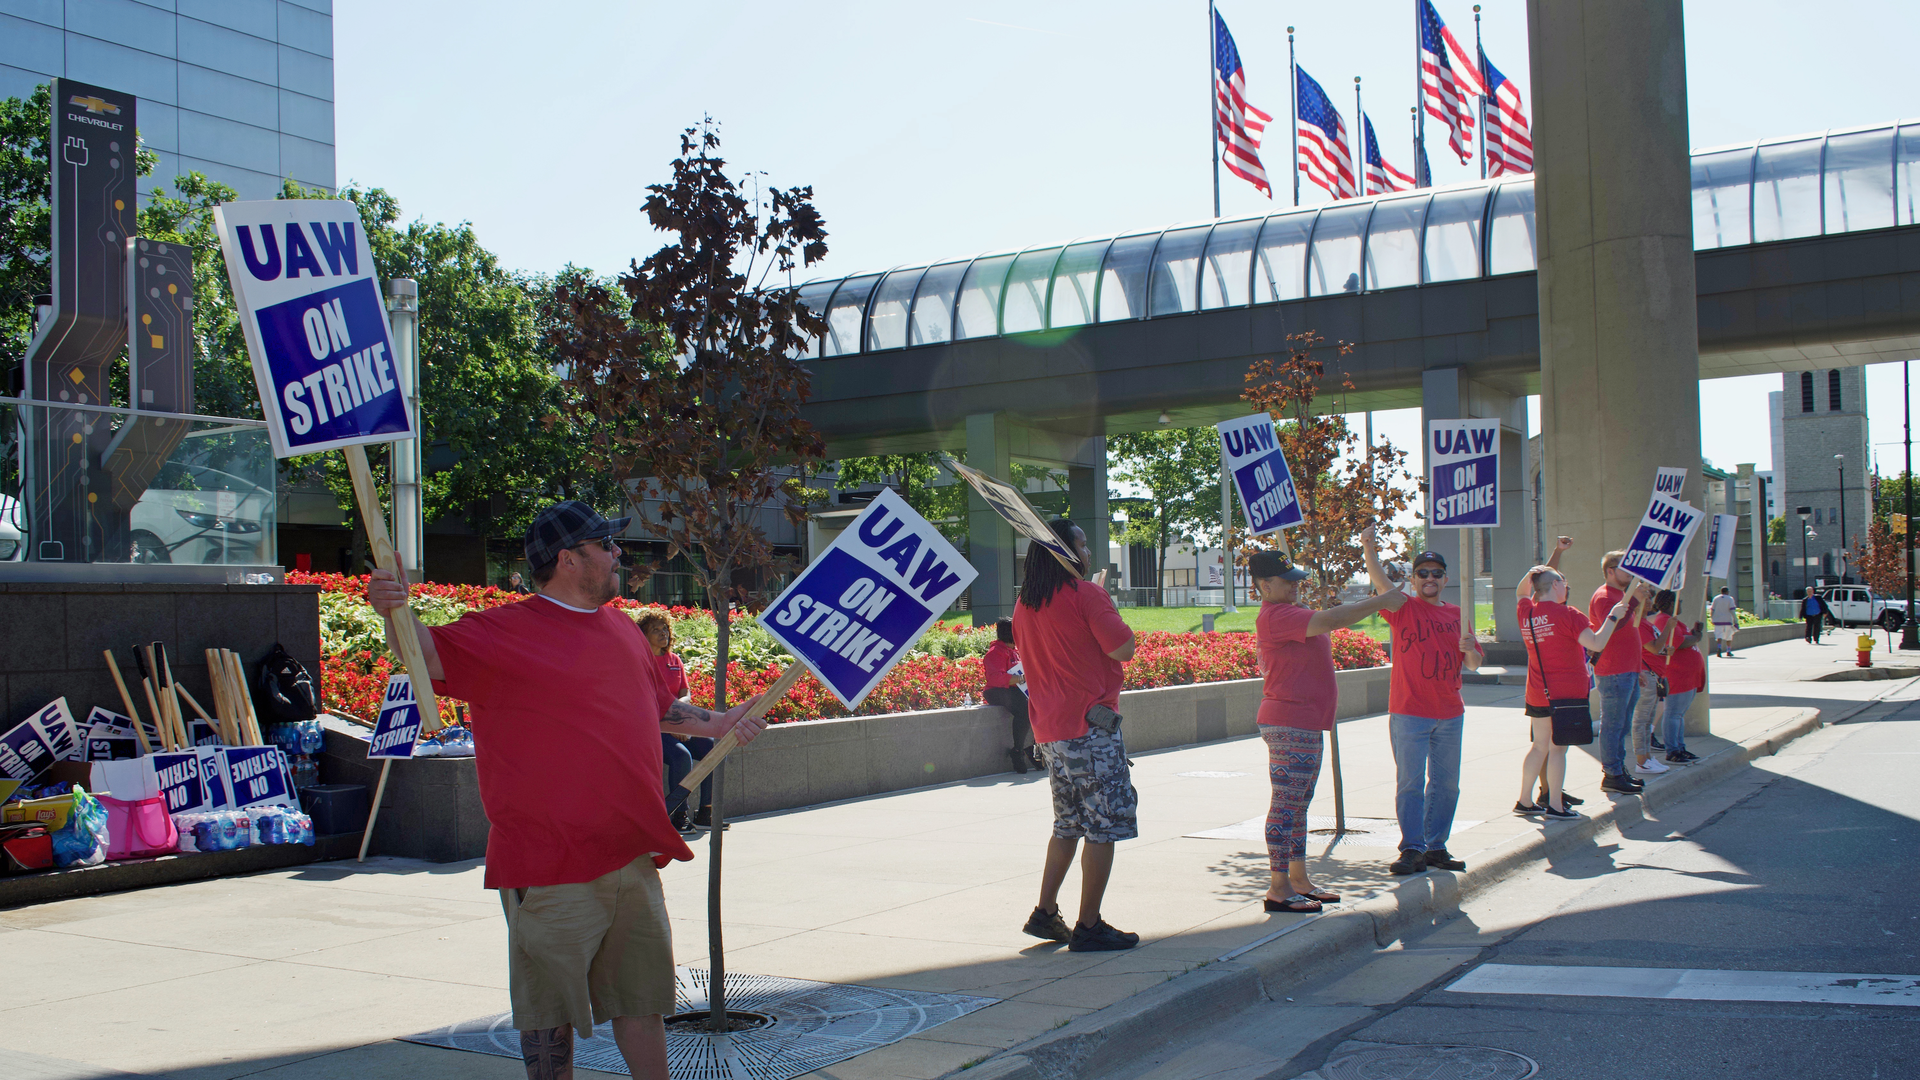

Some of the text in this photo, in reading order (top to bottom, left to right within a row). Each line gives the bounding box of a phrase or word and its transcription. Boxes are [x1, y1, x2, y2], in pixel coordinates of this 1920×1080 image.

[68, 112, 124, 131] CHEVROLET
[236, 222, 359, 281] UAW
[303, 297, 352, 361] ON
[283, 341, 395, 435] STRIKE
[1223, 422, 1274, 458] UAW
[1434, 428, 1496, 455] UAW
[1253, 460, 1276, 492] ON
[1454, 462, 1477, 491] ON
[1656, 473, 1685, 493] UAW
[1249, 478, 1295, 528] STRIKE
[1436, 483, 1495, 522] STRIKE
[1649, 499, 1694, 532] UAW
[858, 503, 961, 603] UAW
[1645, 532, 1669, 551] ON
[1624, 549, 1672, 571] STRIKE
[839, 577, 897, 624] ON
[775, 593, 895, 674] STRIKE
[386, 682, 416, 702] UA
[40, 703, 74, 756] UAW
[389, 707, 410, 729] ON
[18, 739, 46, 763] ON
[371, 724, 418, 753] STRIKE
[156, 758, 198, 790] STRIK
[231, 750, 278, 783] STRIKE
[168, 785, 188, 810] ON
[249, 775, 269, 799] ON
